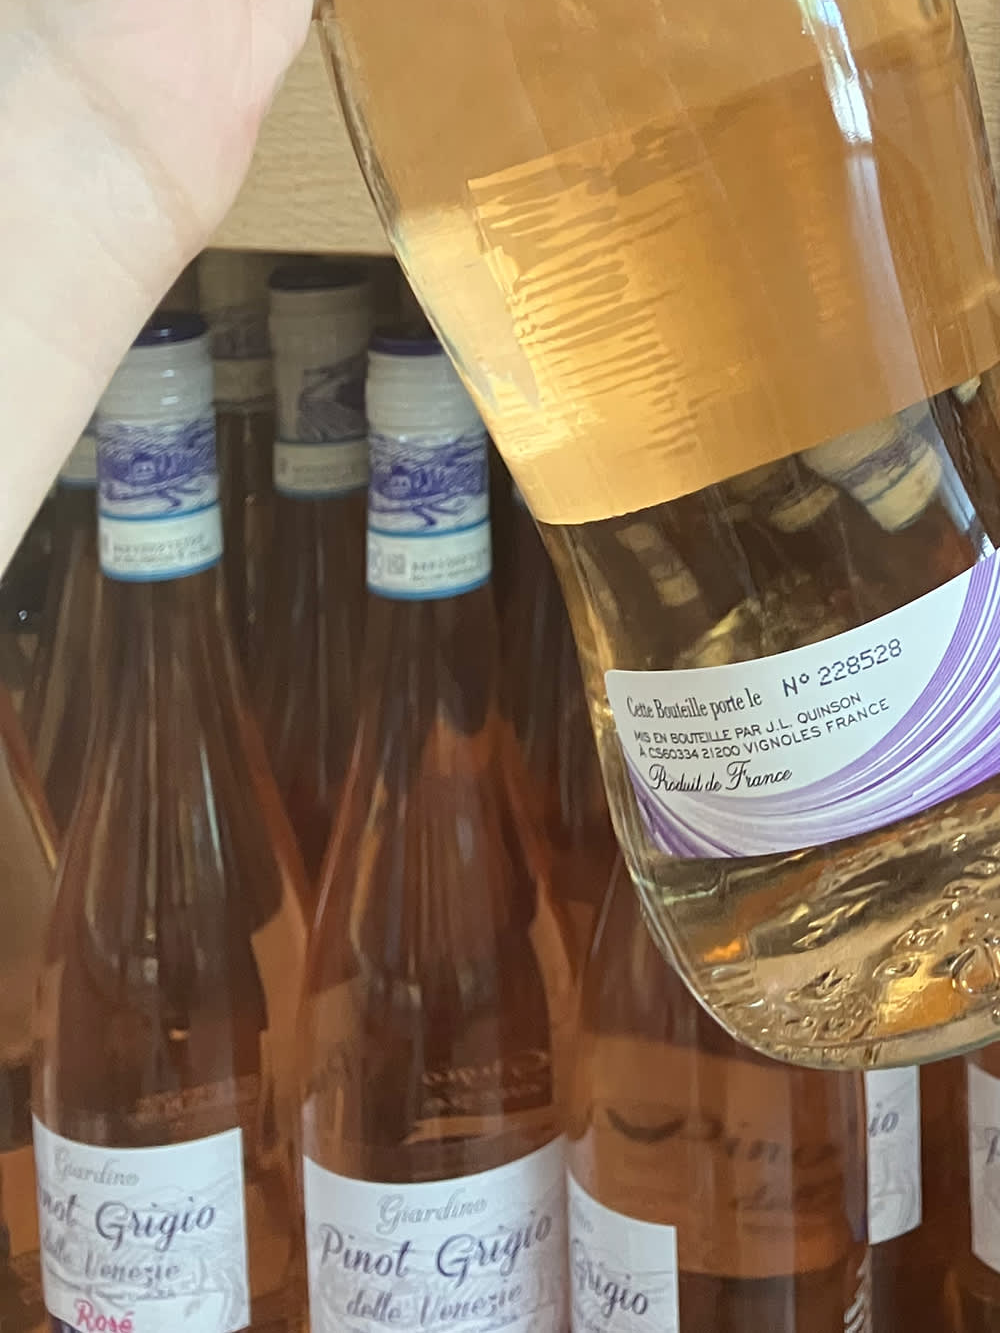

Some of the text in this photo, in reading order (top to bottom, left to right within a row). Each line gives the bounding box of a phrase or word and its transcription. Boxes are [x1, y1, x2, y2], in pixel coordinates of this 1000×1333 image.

[626, 695, 655, 719] Cette
[653, 696, 709, 719] Bouteille
[709, 695, 746, 721] porte
[744, 686, 763, 708] le
[818, 638, 903, 687] 228528
[633, 729, 652, 744] MIS
[653, 732, 668, 744] EN
[670, 729, 732, 744] BOUTEILLE
[735, 724, 762, 739] PAR
[797, 691, 862, 725] QUINSON
[648, 746, 700, 760] CS60334
[702, 745, 741, 760] 21200
[743, 725, 822, 755] VIGNOLES
[825, 697, 891, 732] FRANCE
[648, 759, 793, 793] Produit de France
[95, 1195, 216, 1253] Grigio
[317, 1222, 415, 1278] Pinot
[436, 1210, 554, 1290] Grigio
[74, 1297, 135, 1333] Rosé
[346, 1287, 402, 1323] delle
[420, 1279, 522, 1326] Venezie
